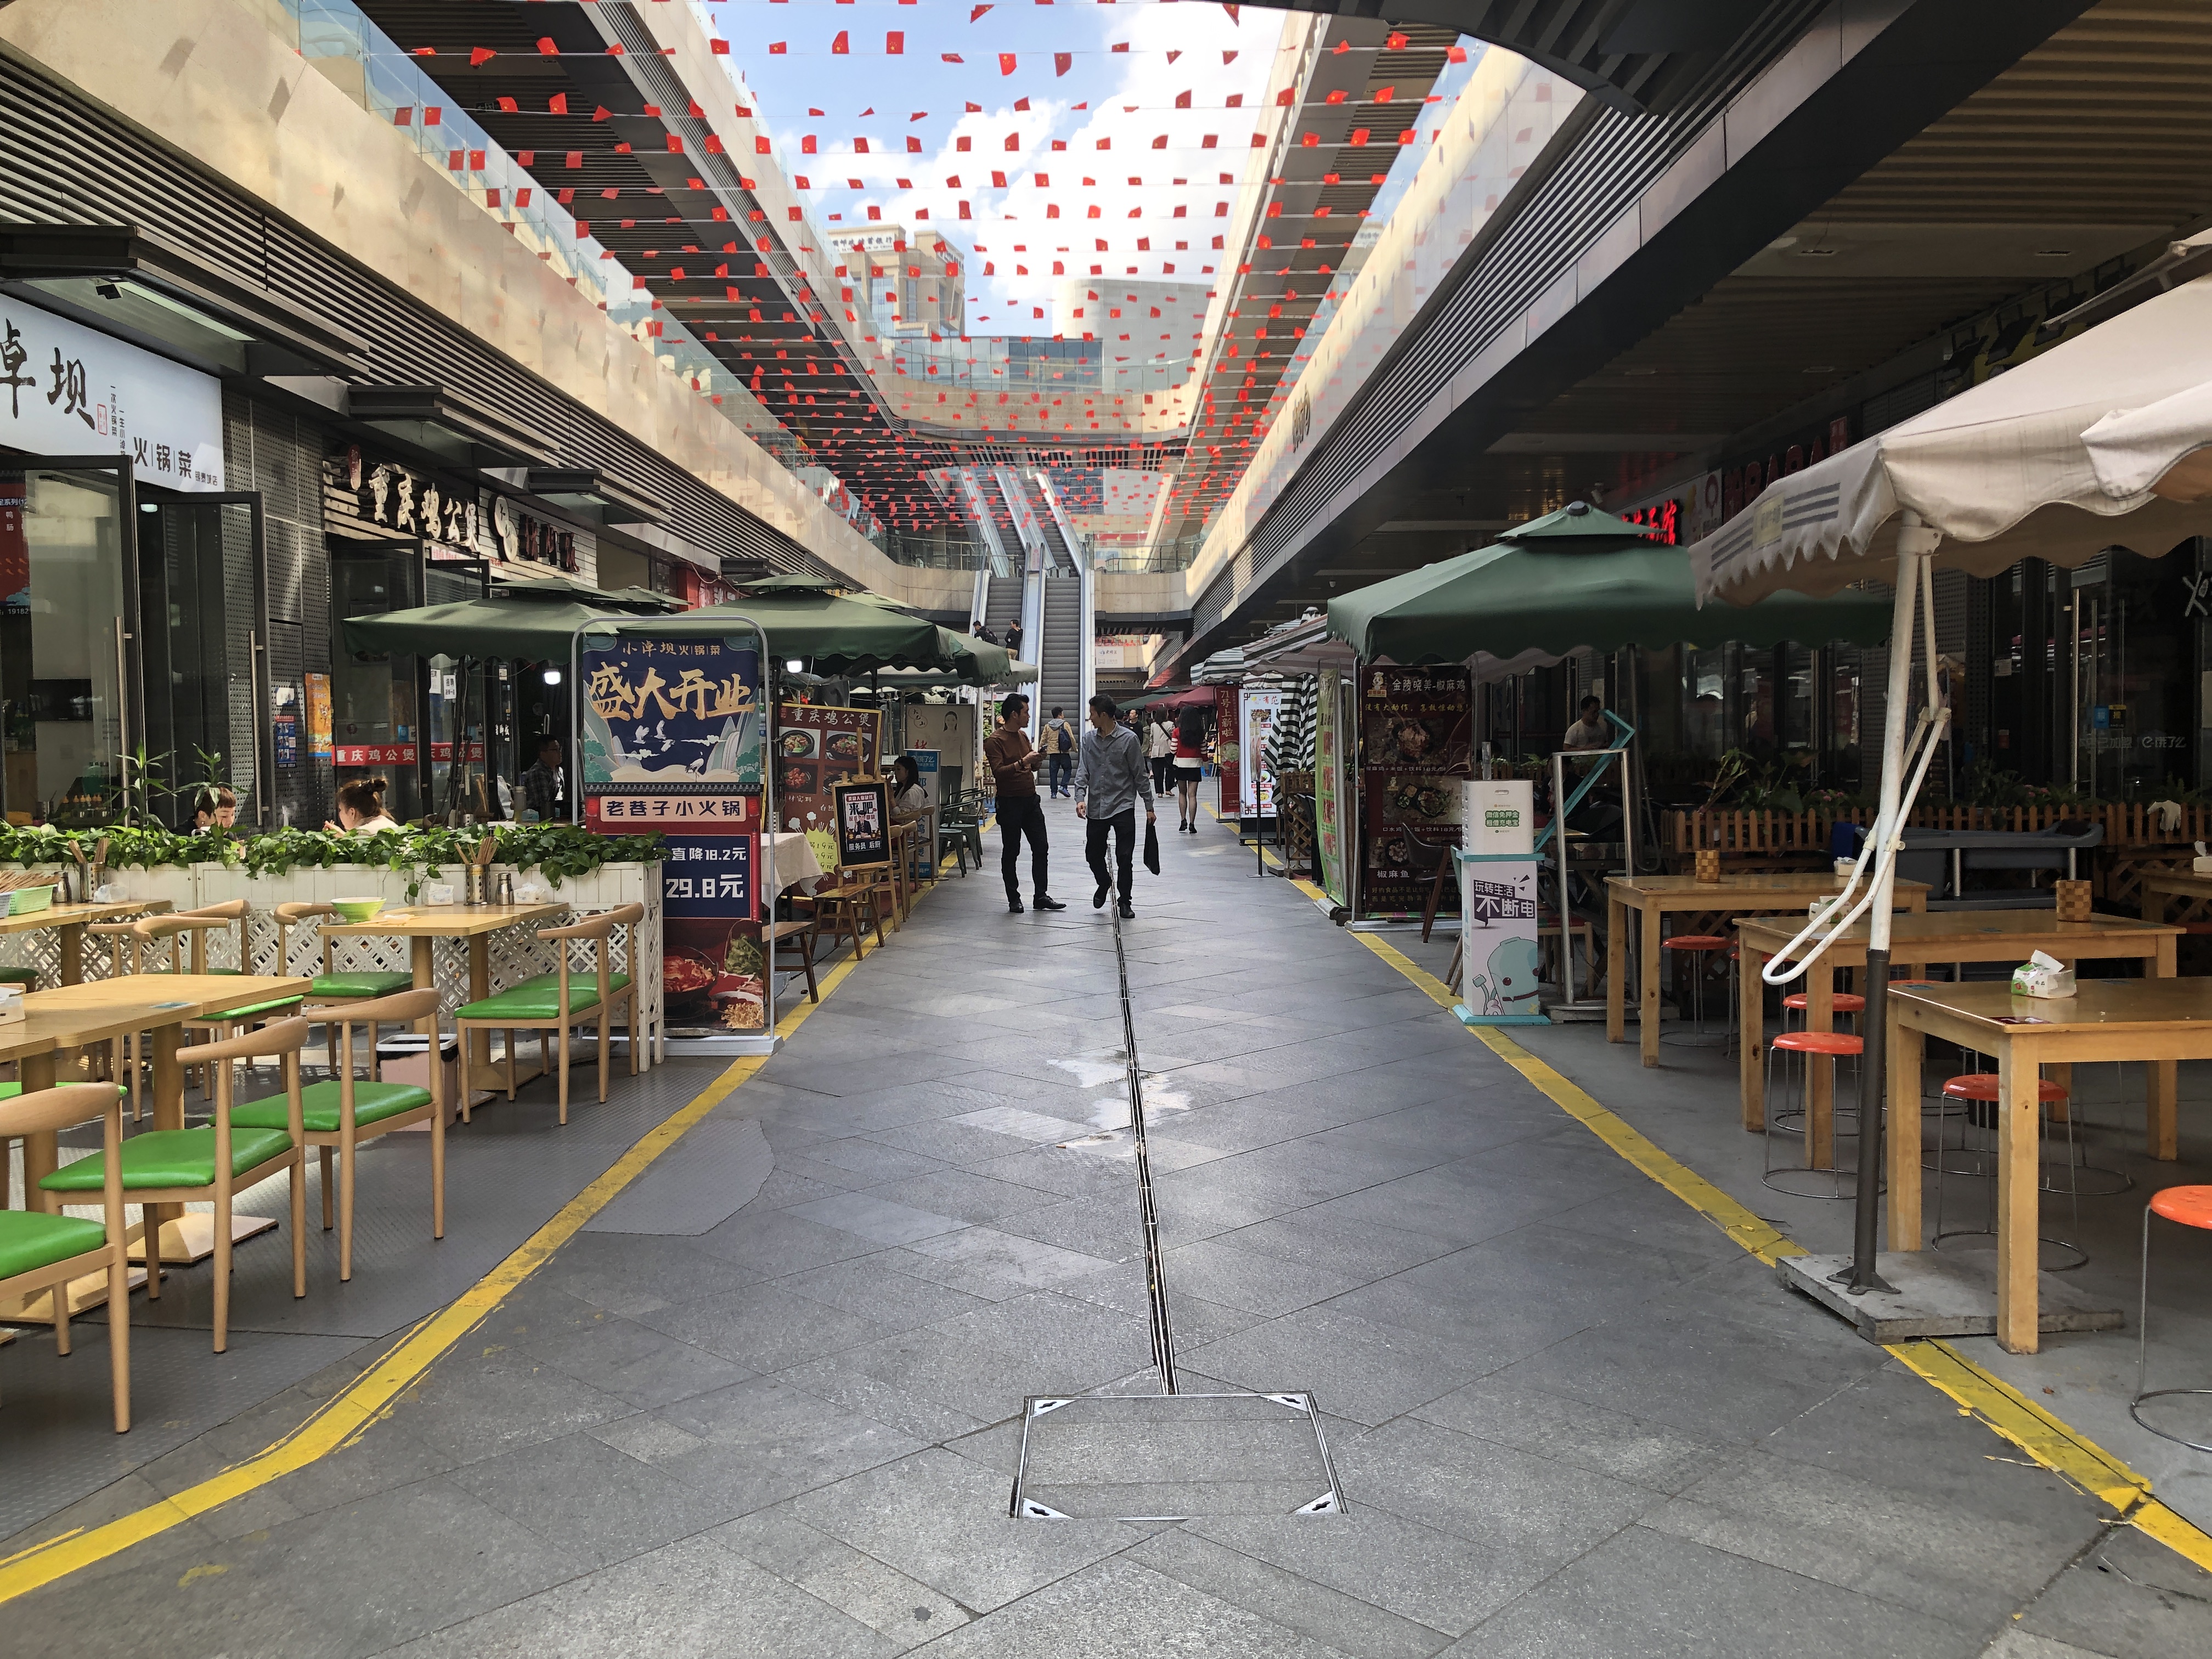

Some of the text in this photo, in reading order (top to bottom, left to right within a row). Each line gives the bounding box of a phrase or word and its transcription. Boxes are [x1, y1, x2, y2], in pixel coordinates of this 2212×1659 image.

[134, 437, 192, 479] 火锅菜
[368, 464, 481, 553] 重庆鸡公煲
[589, 661, 756, 721] 盛大开业
[1392, 678, 1466, 692] 金陵晓美-椒麻鸡
[792, 708, 871, 727] 重庆鸡公煲
[336, 748, 415, 762] 重庆鸡公煲
[607, 800, 740, 817] 老巷子小火锅
[849, 802, 874, 815] 来吧
[653, 847, 746, 861] 直降18.2元
[1376, 870, 1410, 879] 椒麻鱼
[665, 874, 743, 898] 29.8元
[1474, 881, 1513, 898] 玩转生活
[1476, 895, 1534, 917] 不断电
